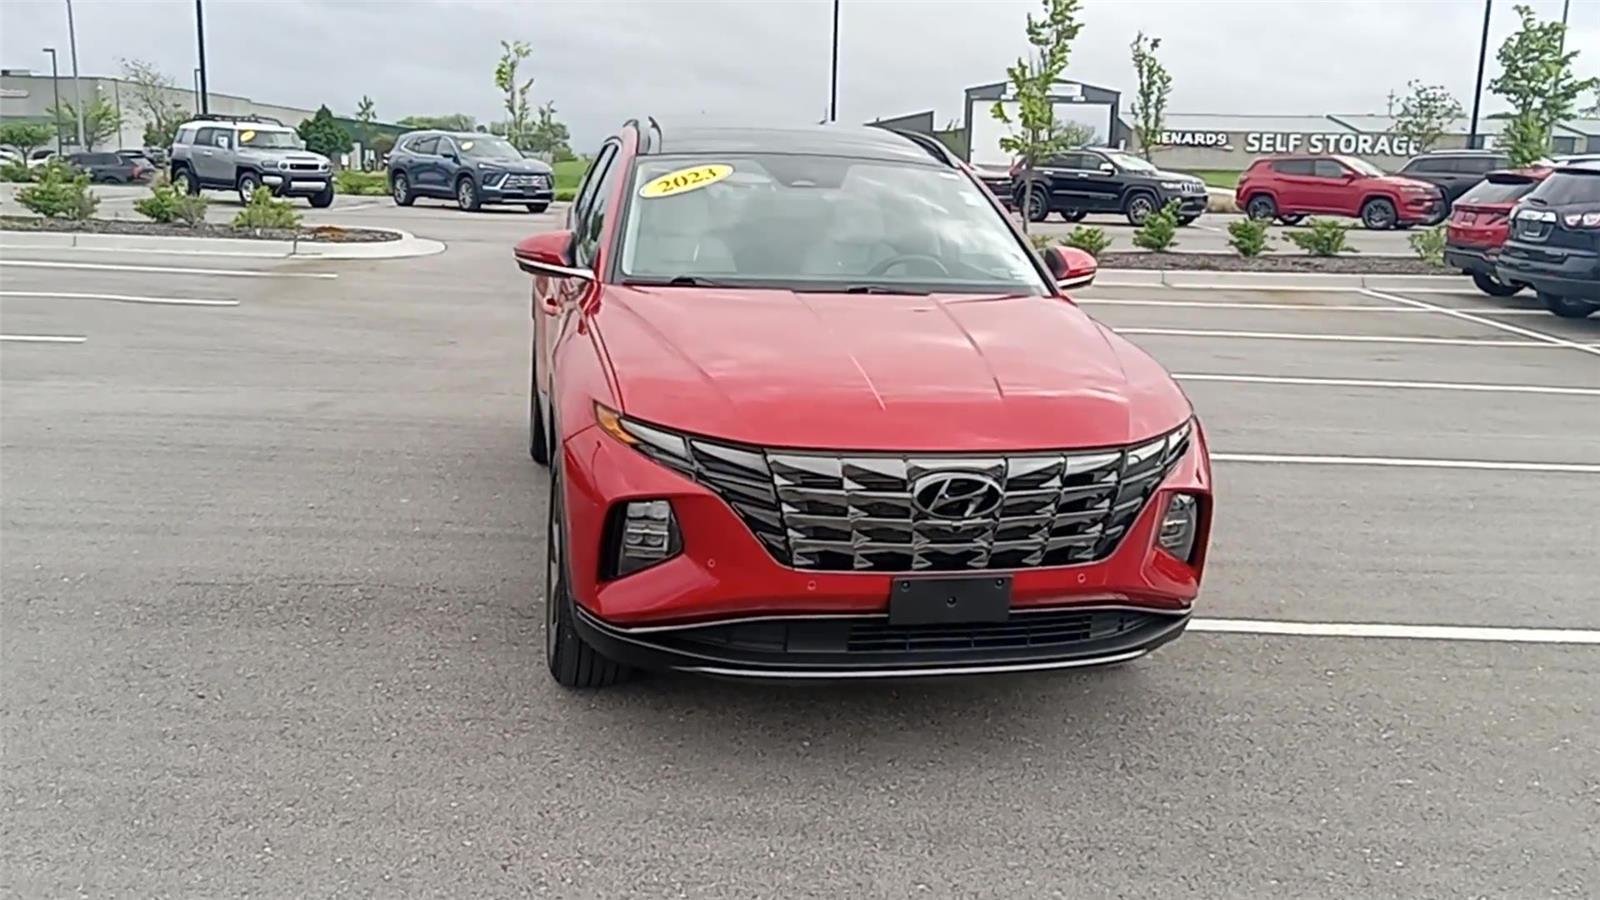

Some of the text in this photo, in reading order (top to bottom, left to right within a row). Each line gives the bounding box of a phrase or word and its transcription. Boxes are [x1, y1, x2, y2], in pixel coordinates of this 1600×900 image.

[1246, 133, 1300, 152] SELF
[1309, 134, 1421, 155] STORAGE
[657, 168, 718, 193] 2023
